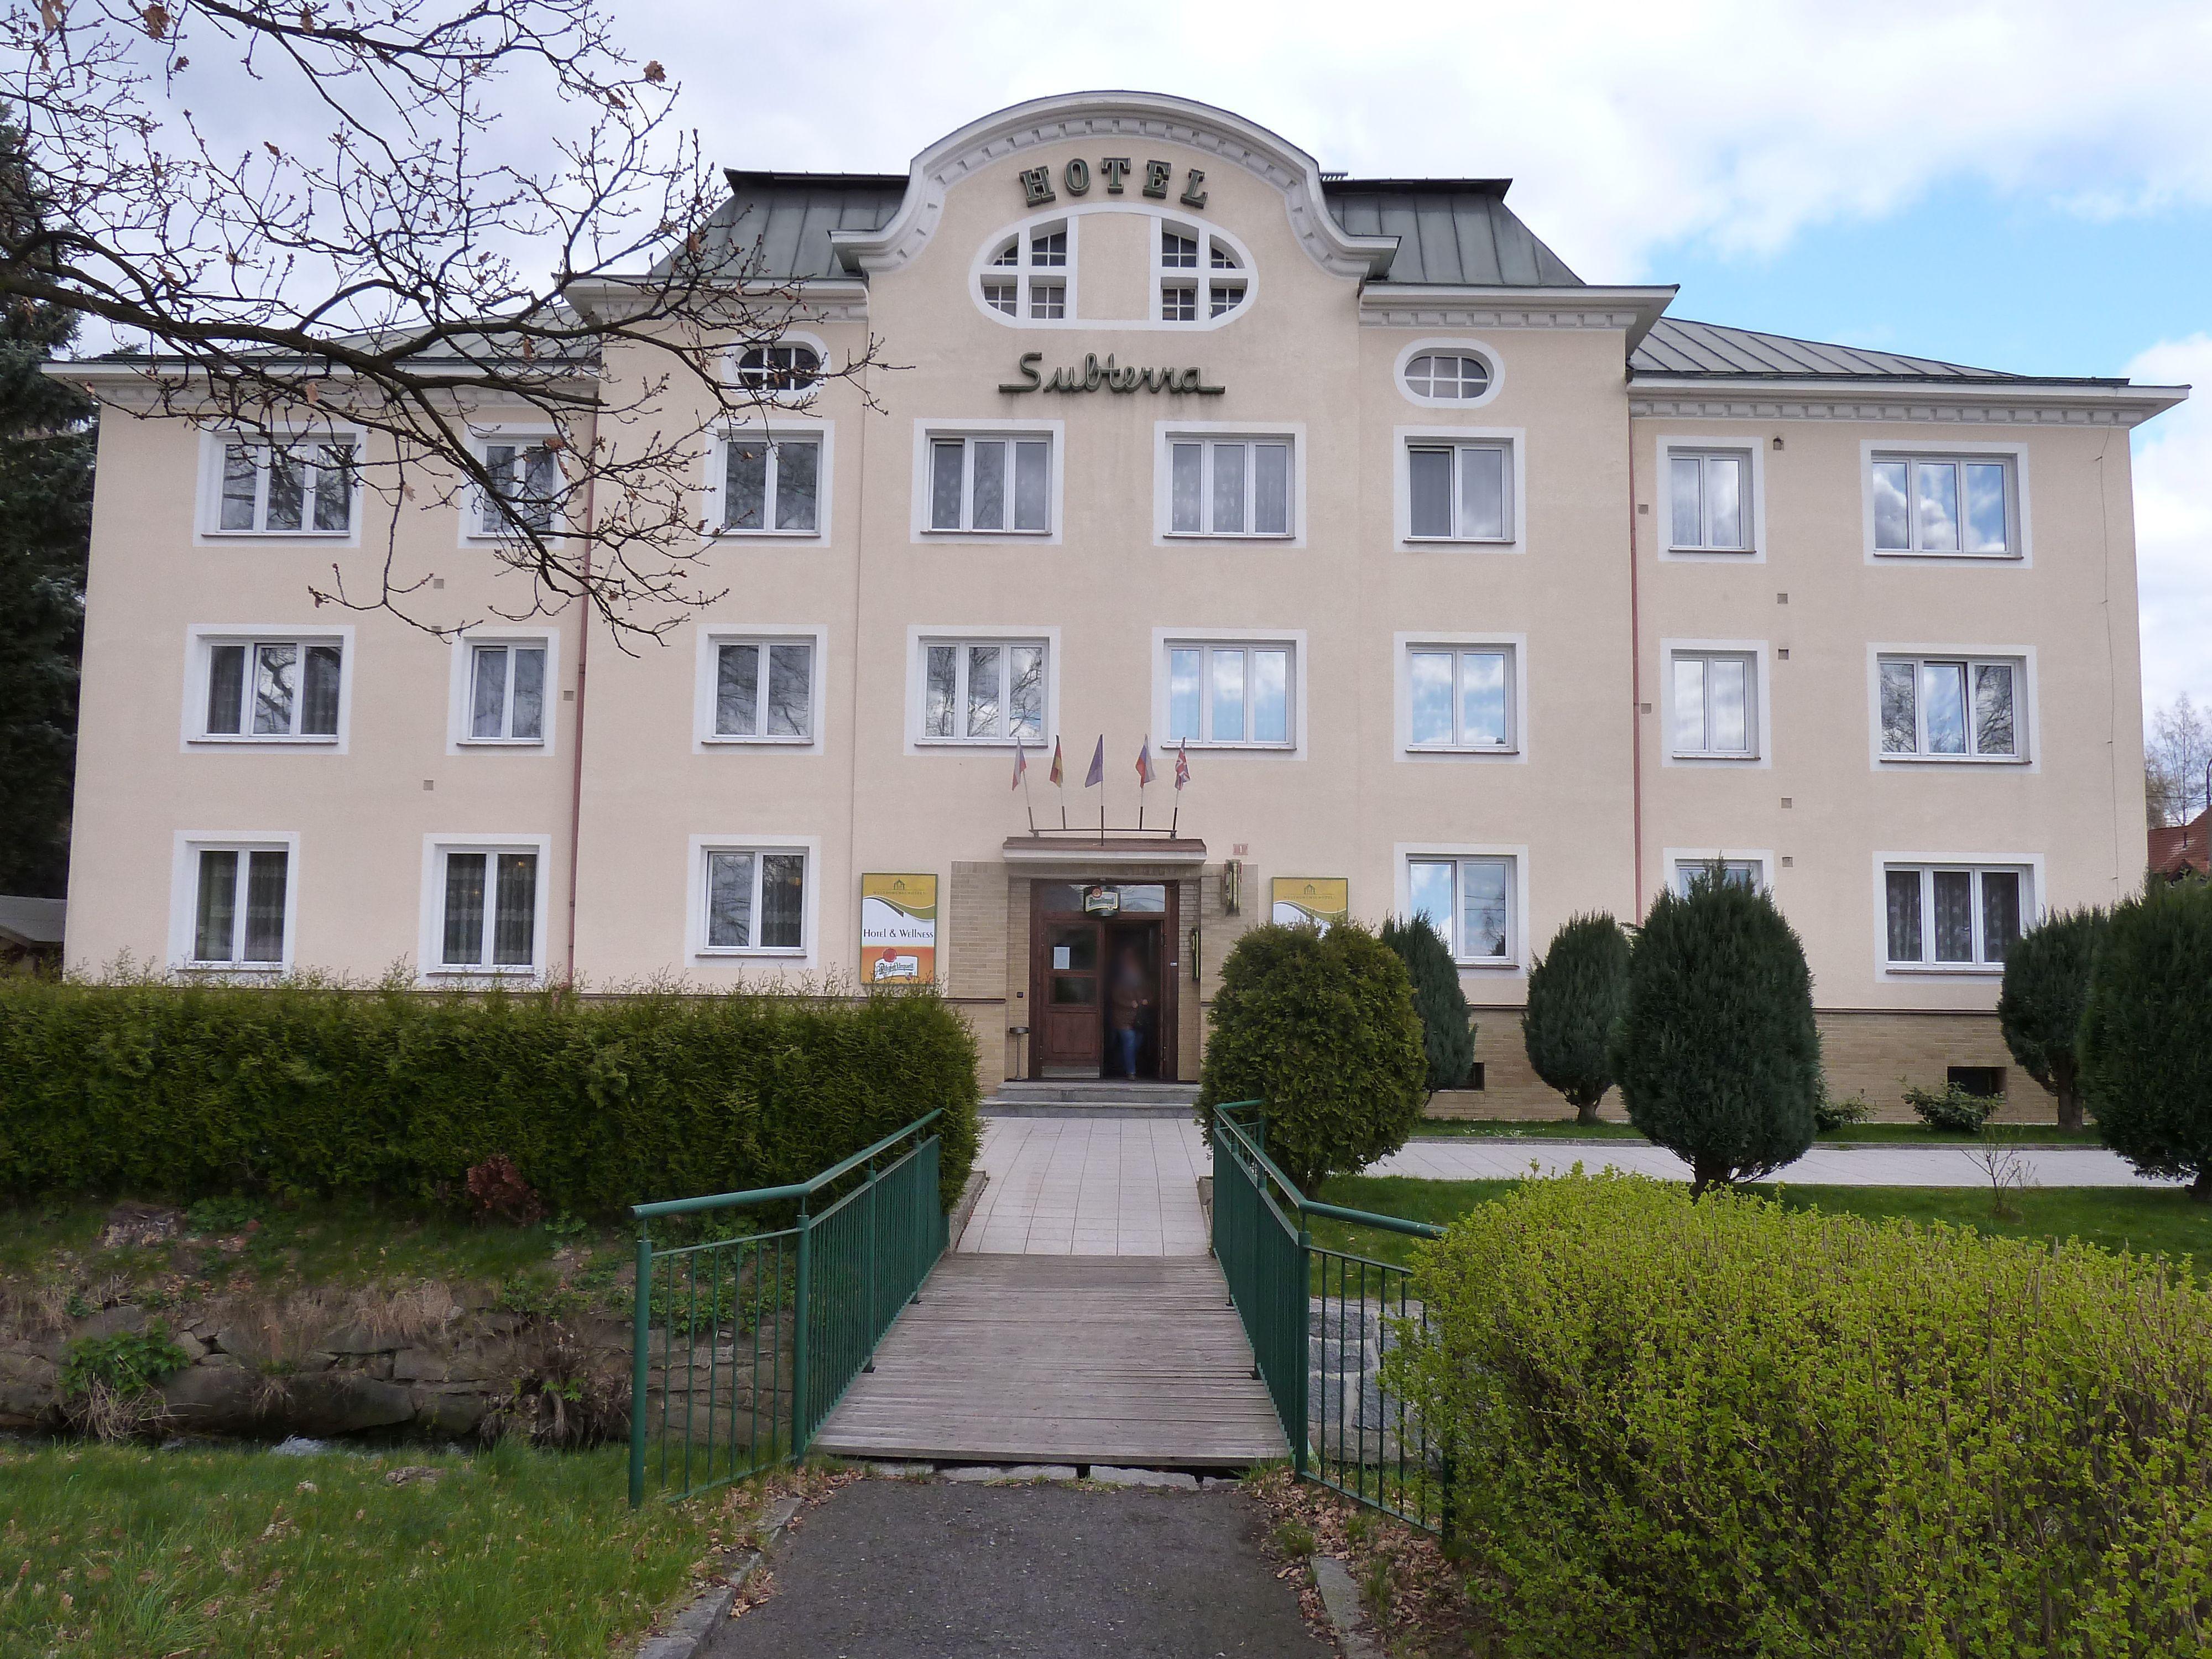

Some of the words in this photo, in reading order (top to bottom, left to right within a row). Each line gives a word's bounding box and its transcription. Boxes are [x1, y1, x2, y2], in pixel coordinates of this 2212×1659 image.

[1019, 157, 1208, 209] HOTEL
[998, 352, 1225, 394] Subterra
[864, 928, 886, 937] Hotel
[889, 929, 896, 937] &
[899, 928, 933, 938] Wellness
